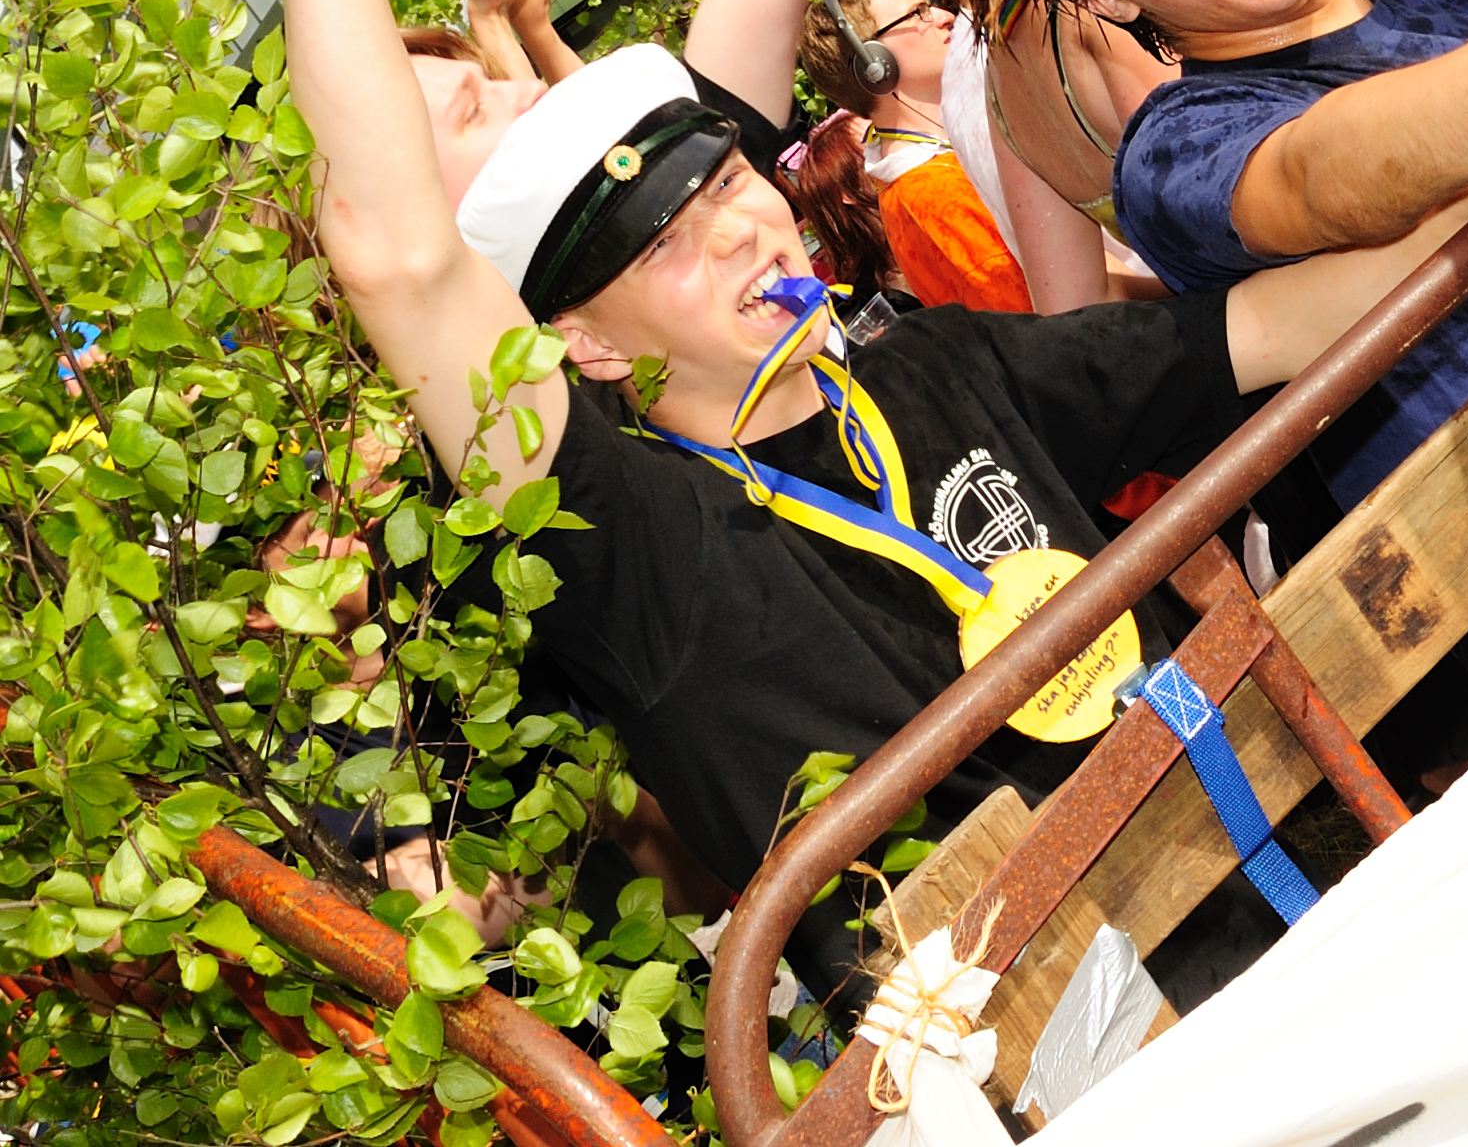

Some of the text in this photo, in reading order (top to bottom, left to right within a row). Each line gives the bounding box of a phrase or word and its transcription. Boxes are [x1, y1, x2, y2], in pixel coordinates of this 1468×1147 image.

[1044, 574, 1060, 593] en
[1037, 690, 1060, 715] ska
[1055, 663, 1079, 692] jag
